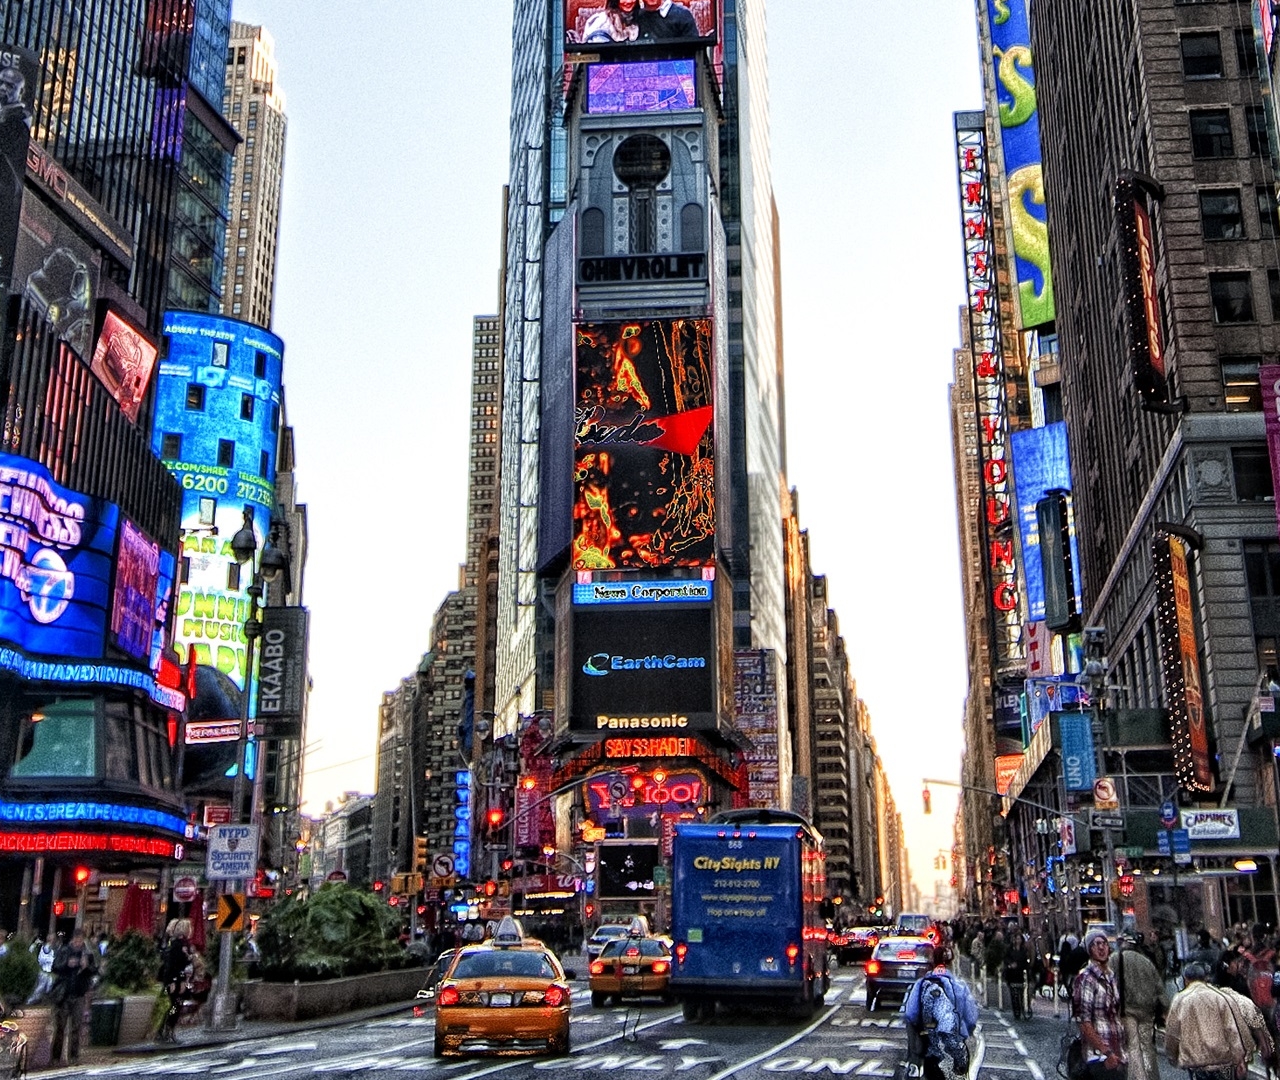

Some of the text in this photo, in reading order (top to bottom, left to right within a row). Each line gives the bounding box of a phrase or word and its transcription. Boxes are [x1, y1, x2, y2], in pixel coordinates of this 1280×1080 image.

[580, 257, 702, 282] CHEVROLET
[182, 474, 228, 494] 6200
[982, 416, 1017, 612] YOUNG
[184, 535, 217, 553] AR
[595, 585, 708, 602] News Corporation
[611, 655, 705, 671] EarthCam
[596, 714, 688, 729] Panasonic
[693, 856, 781, 873] CitySights NY
[762, 1057, 896, 1077] ONL
